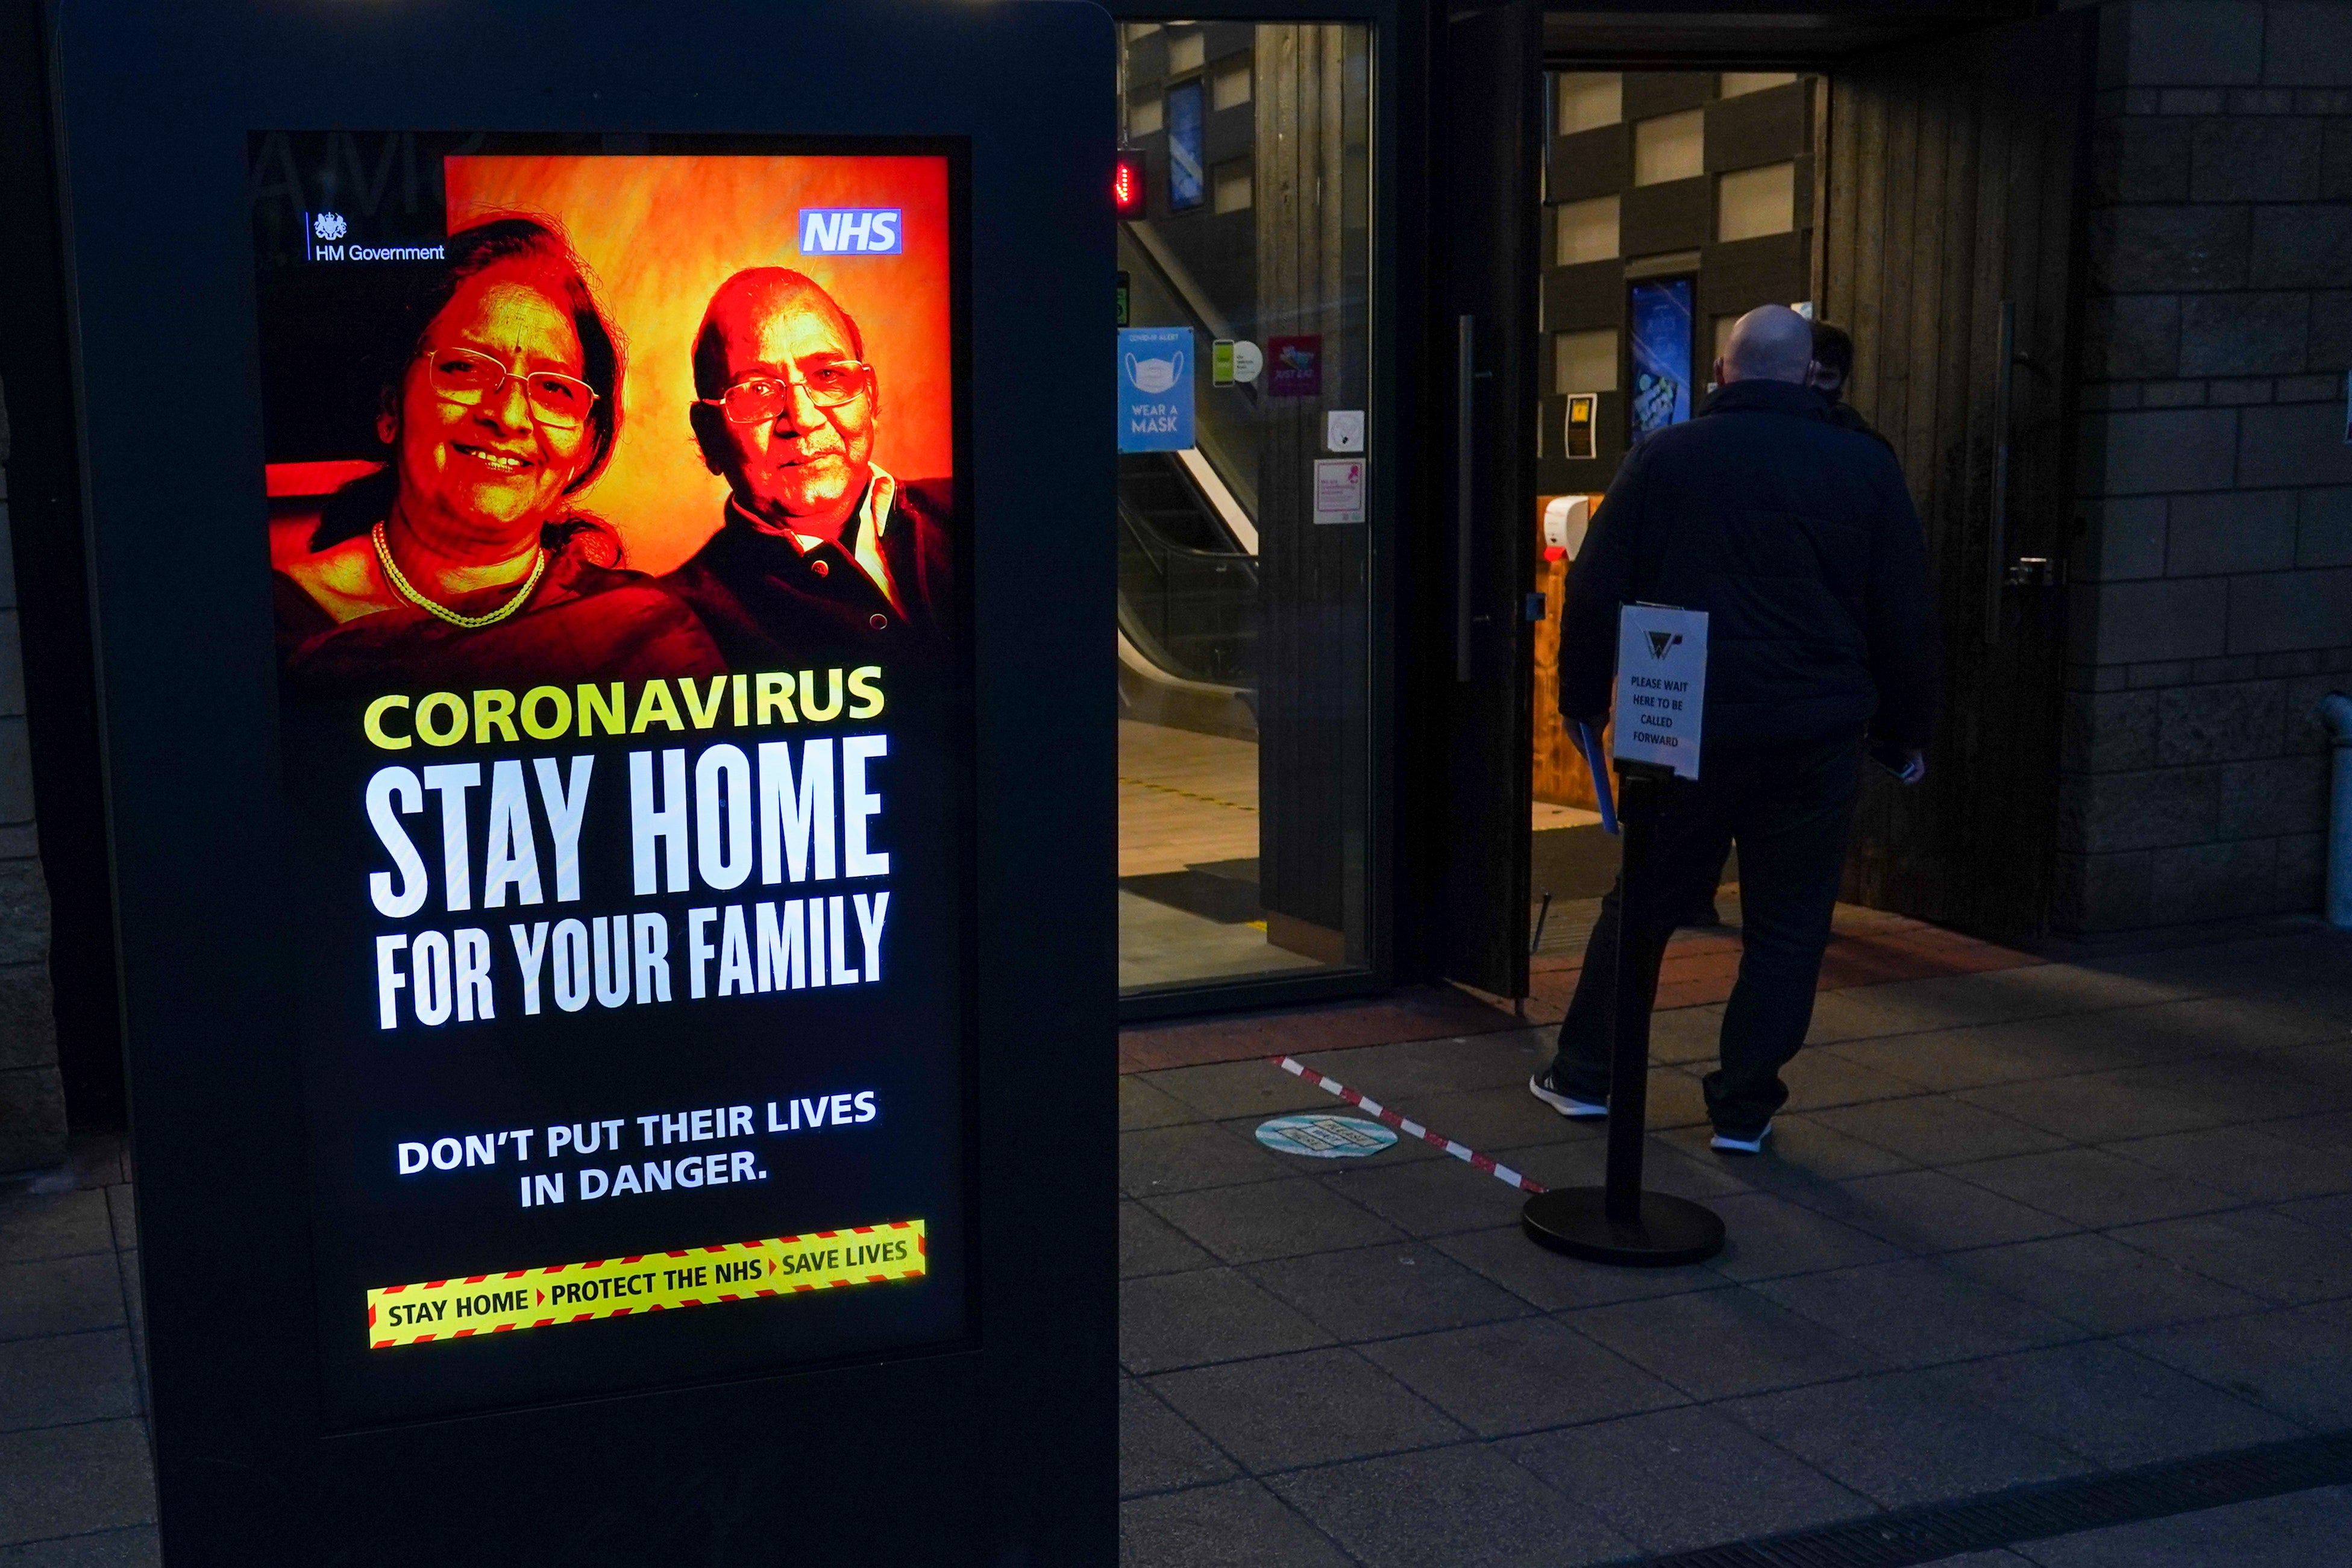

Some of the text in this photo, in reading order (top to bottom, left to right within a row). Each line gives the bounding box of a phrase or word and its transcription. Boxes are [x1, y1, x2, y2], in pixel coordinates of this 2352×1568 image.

[803, 212, 898, 251] NHS
[316, 244, 445, 261] HM Government
[1132, 404, 1179, 416] WEAR A
[1131, 416, 1178, 433] MASK
[1631, 676, 1689, 692] PLEASE WAIT
[363, 665, 885, 751] CORONAVIRUS
[1632, 694, 1683, 711] HERE TO BE
[1640, 714, 1673, 728] CALLED
[1633, 731, 1678, 748] FORWARD
[365, 734, 890, 918] STAY HOME
[376, 891, 891, 1030] FOR YOUR FAMILY
[398, 1091, 876, 1174] DON'T PUT THEIR LIVES
[521, 1151, 767, 1208] IN DANGER.
[389, 1240, 908, 1327] STAY HOME PROTECT THE NHS SAVE LIVES
